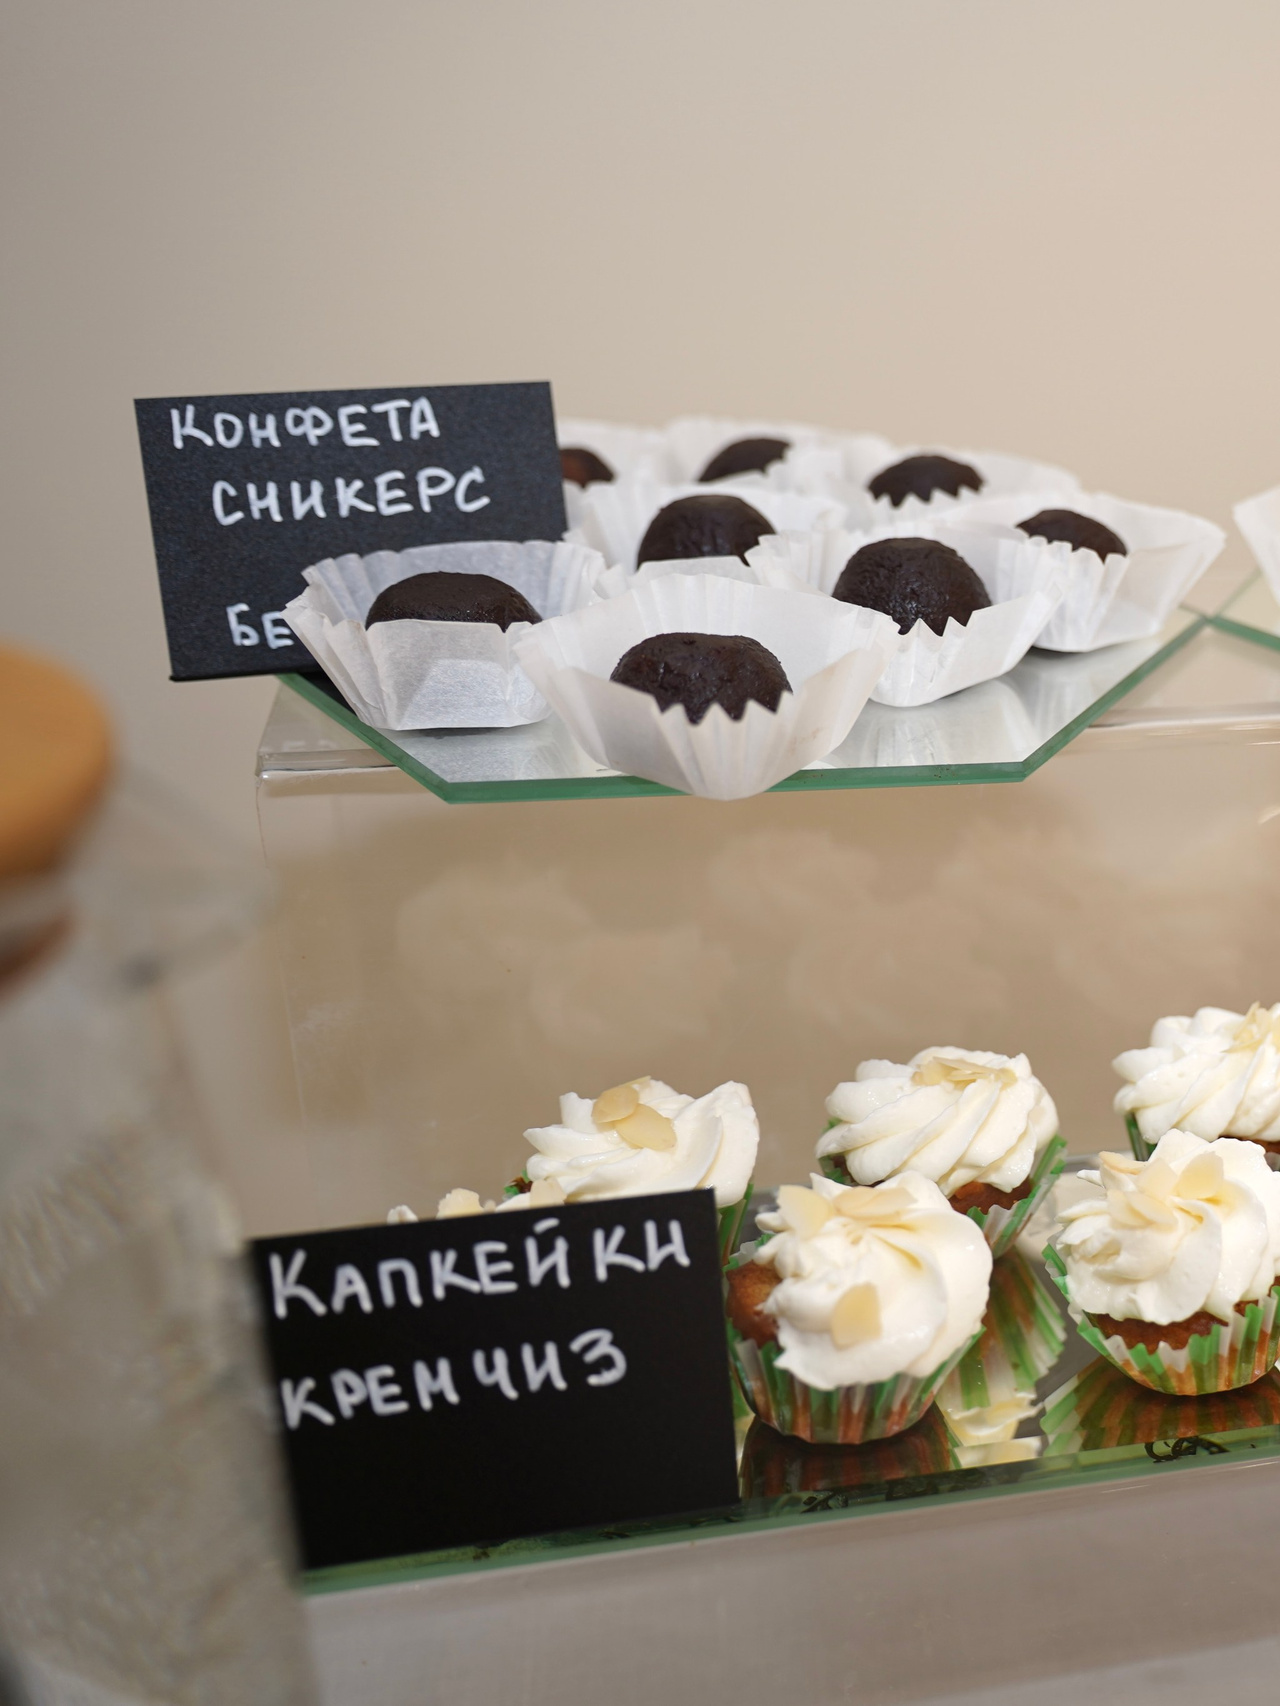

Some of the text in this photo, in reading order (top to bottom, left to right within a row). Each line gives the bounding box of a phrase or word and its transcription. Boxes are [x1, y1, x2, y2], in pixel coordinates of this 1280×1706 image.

[170, 397, 440, 450] КОНФЕТА
[211, 465, 491, 526] СНИКЕРС
[225, 602, 295, 650] БЕ
[269, 1218, 690, 1319] КАПКЕЙКИ
